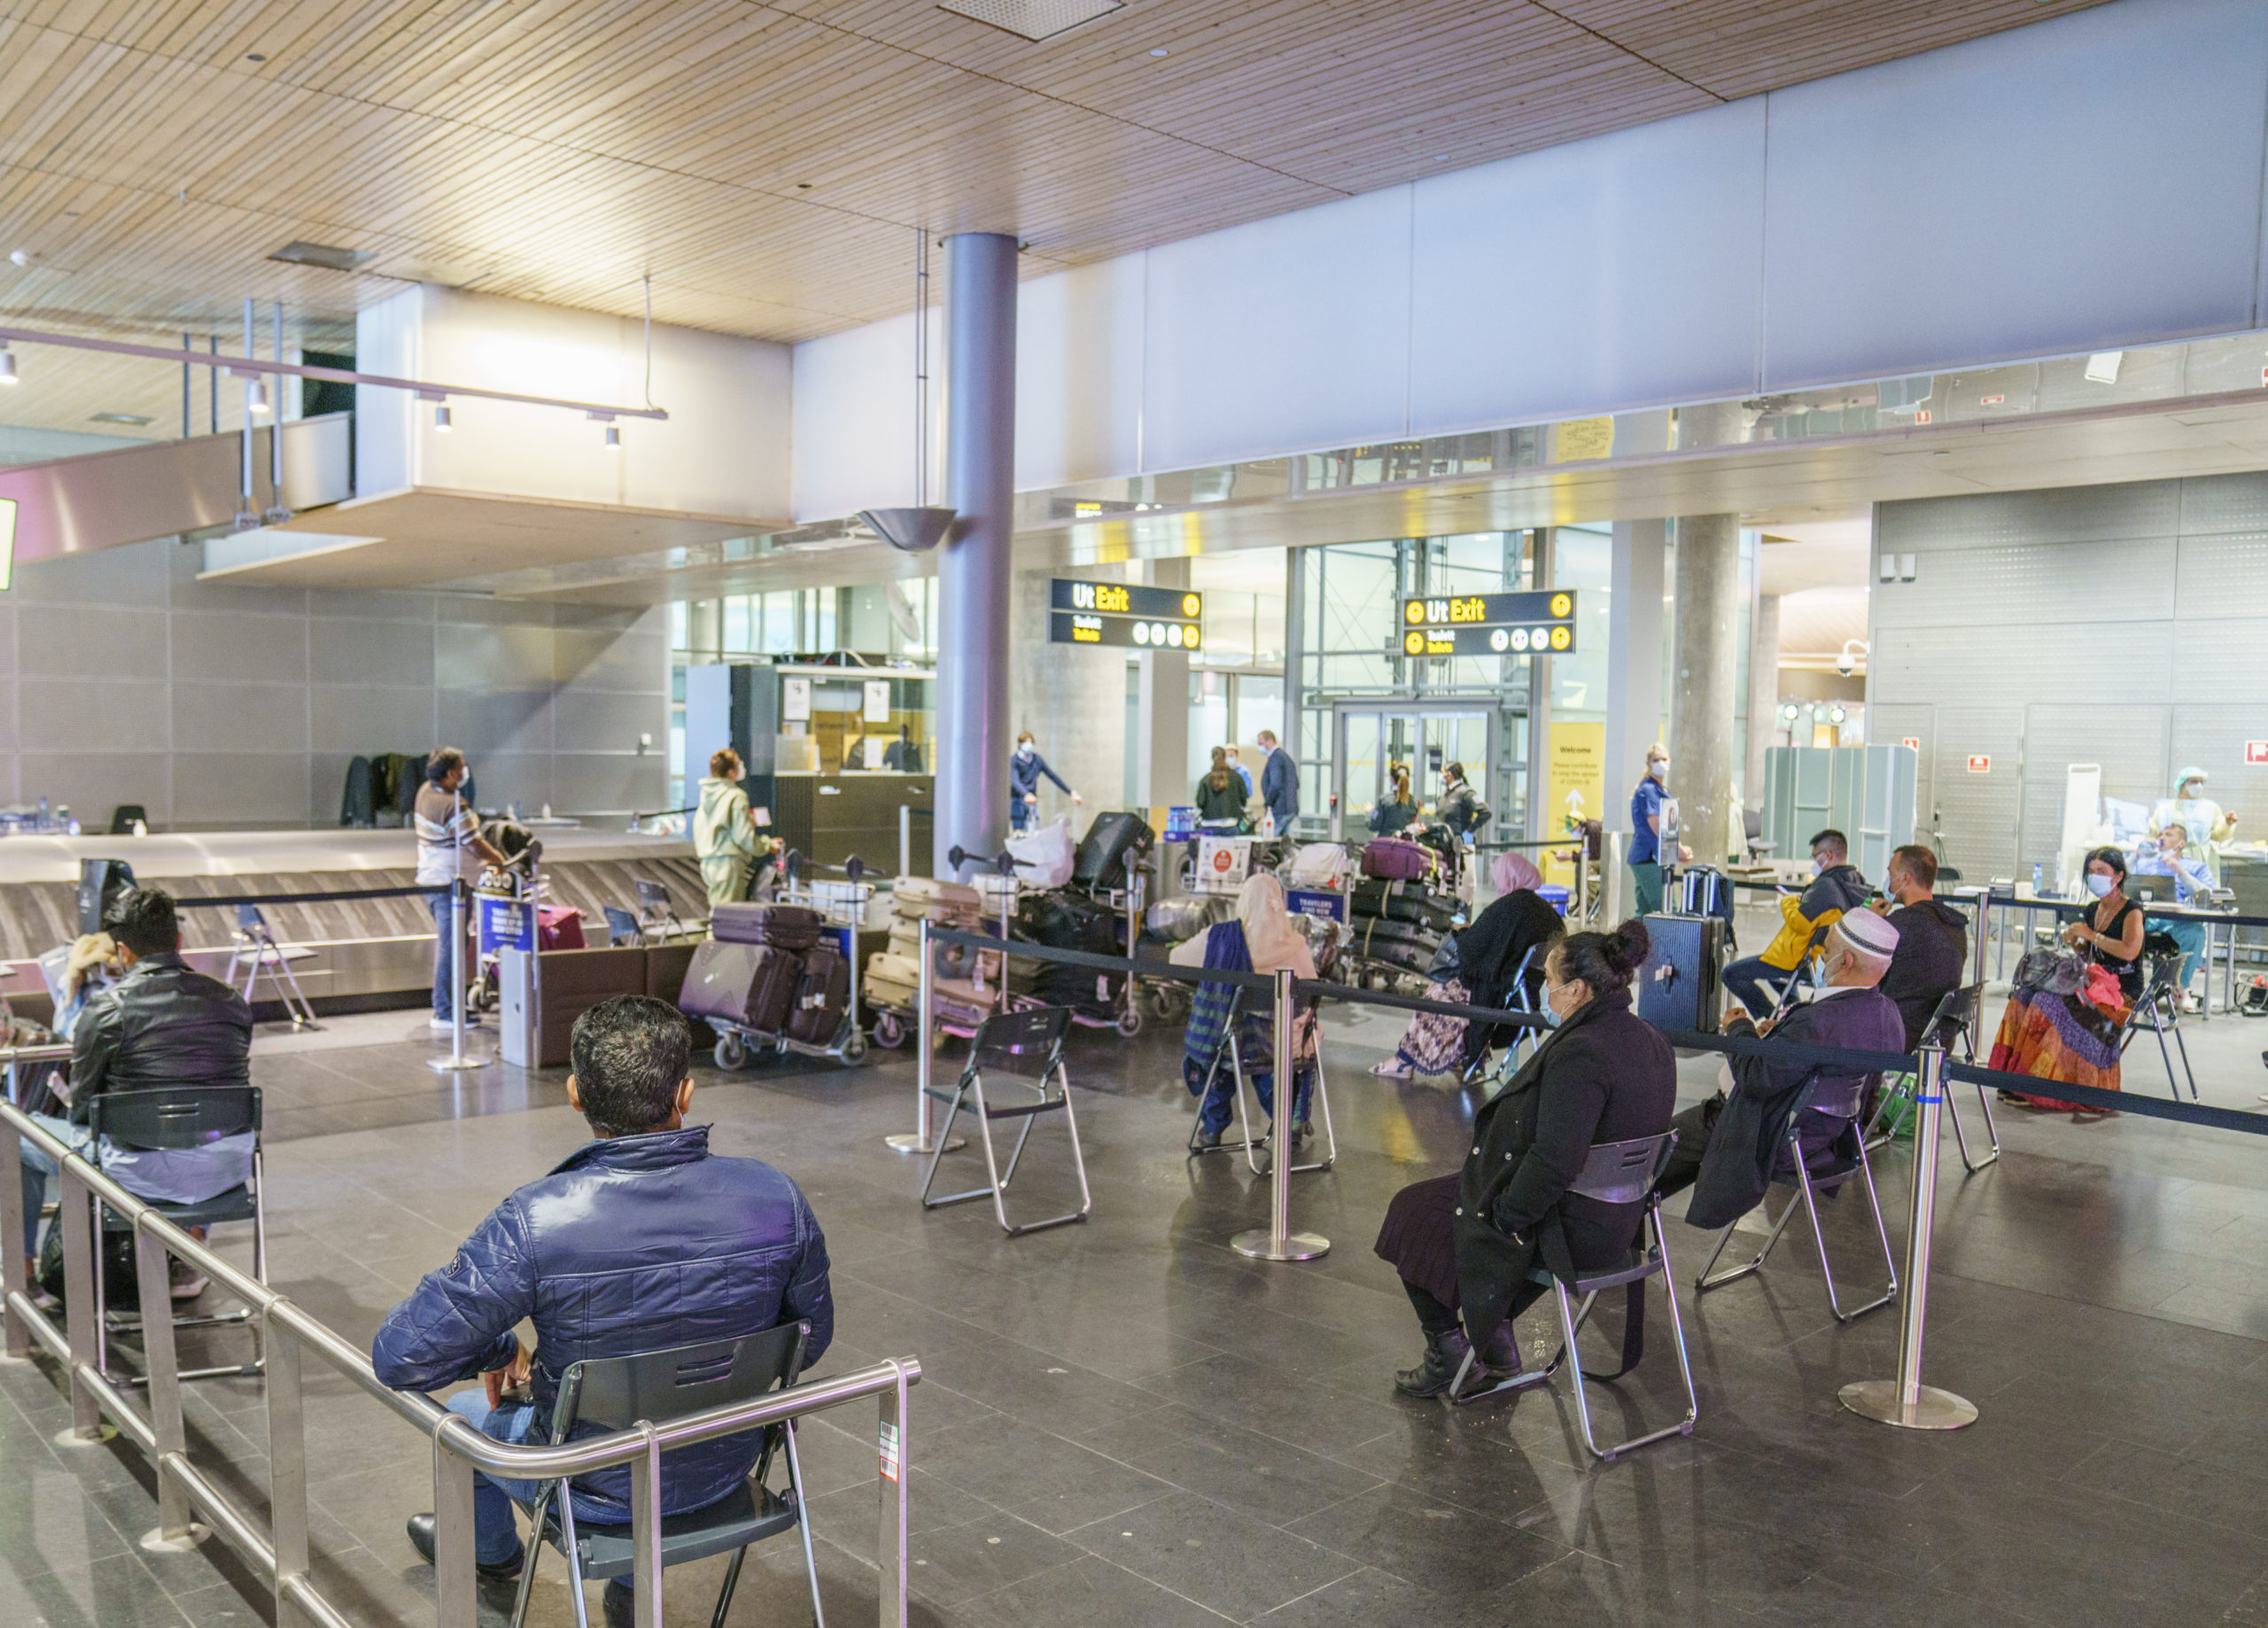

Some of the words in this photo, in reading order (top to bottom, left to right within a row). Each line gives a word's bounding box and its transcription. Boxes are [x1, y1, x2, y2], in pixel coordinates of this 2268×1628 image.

[1073, 584, 1095, 609] Ut
[1096, 585, 1130, 611] Exit
[1427, 601, 1449, 623] Ut
[1450, 598, 1486, 623] Exit
